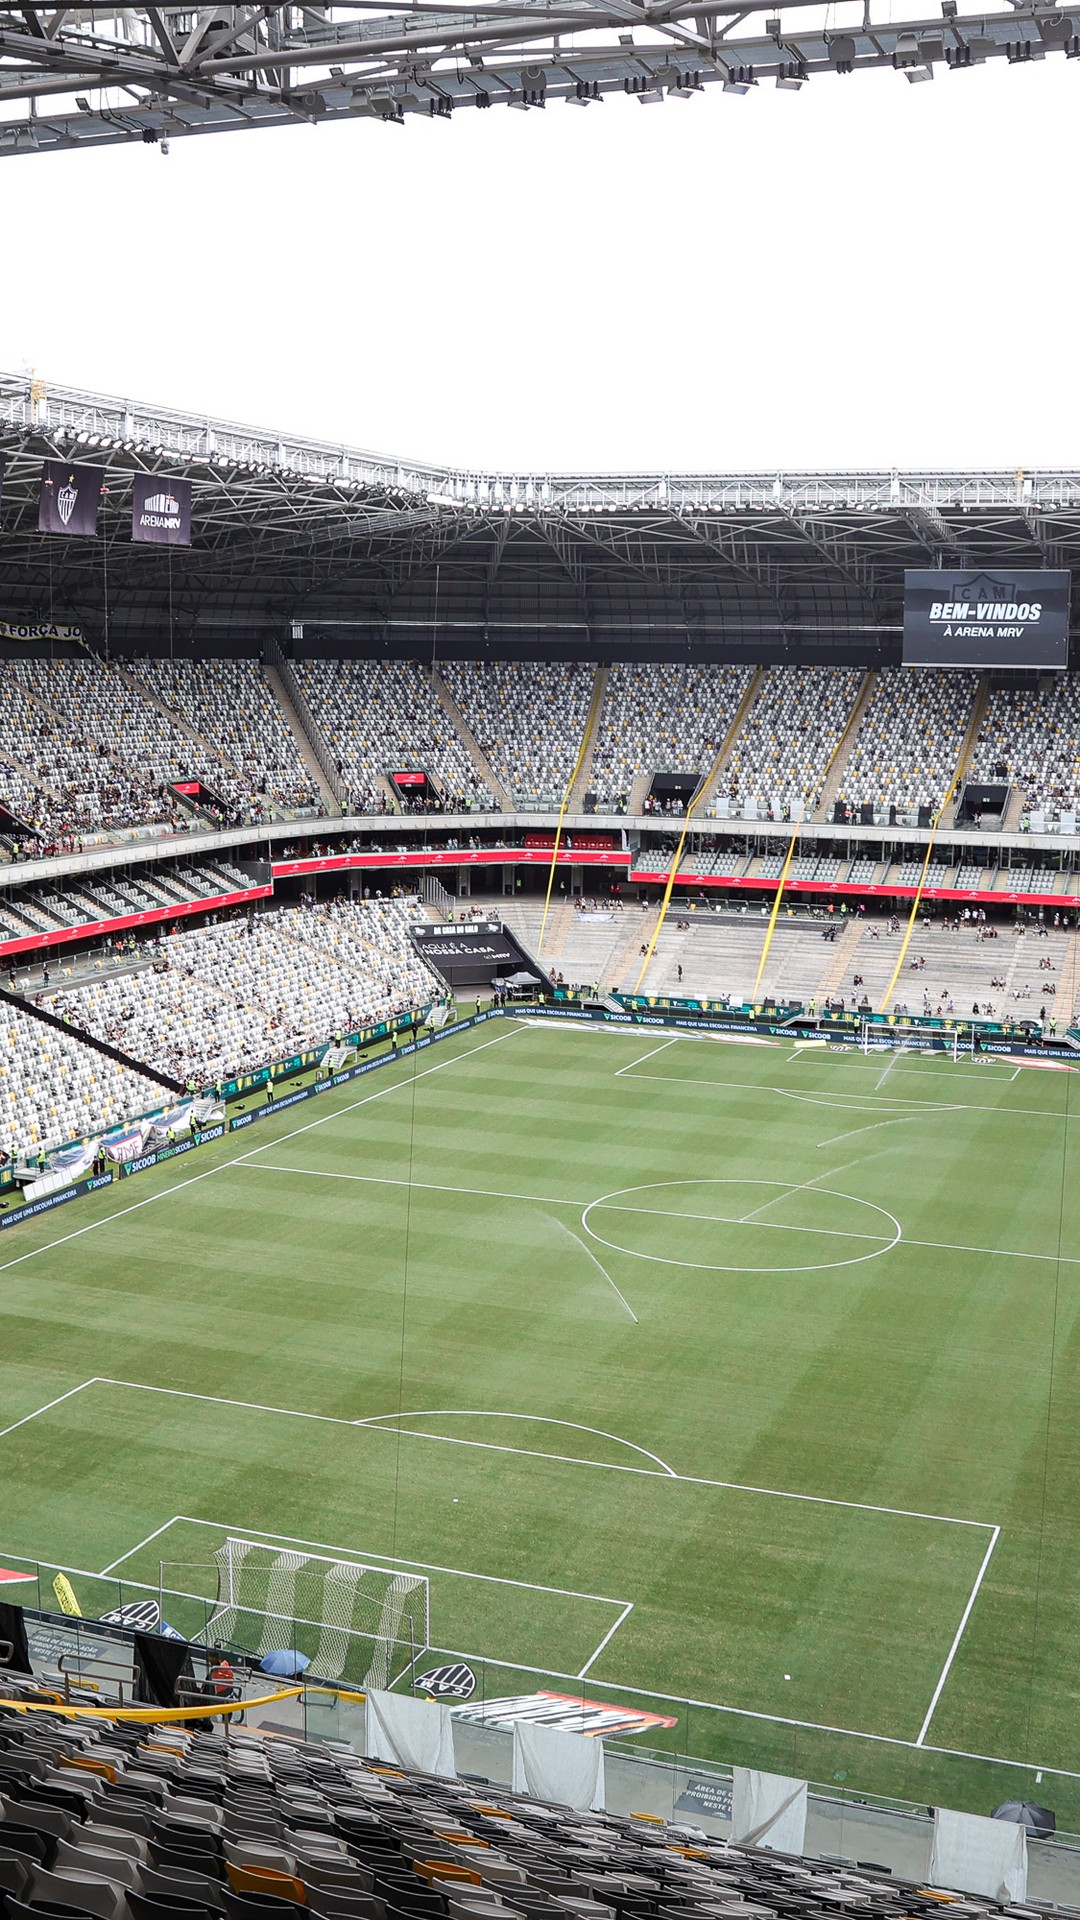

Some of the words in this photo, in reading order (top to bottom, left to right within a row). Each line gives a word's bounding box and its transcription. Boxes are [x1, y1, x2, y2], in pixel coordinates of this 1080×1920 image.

[929, 603, 1042, 620] BEM-VINDOS
[9, 624, 59, 638] FORÇA
[943, 624, 953, 636] À
[954, 627, 994, 637] ARENA
[996, 627, 1024, 637] MRV
[775, 1028, 798, 1036] SICOOB
[808, 1032, 831, 1040] SICOOB
[987, 1044, 1012, 1053] SICOOB
[236, 1114, 252, 1127] SICOOB
[200, 1126, 223, 1143] SICOOB
[131, 1154, 156, 1173] SICOOB
[92, 1174, 112, 1189] SICOOB
[108, 1615, 146, 1628] CAM
[420, 1680, 463, 1694] CAM
[694, 1784, 715, 1794] ÁREA
[686, 1790, 722, 1802] PROIBIDO
[703, 1800, 728, 1811] NESTE
